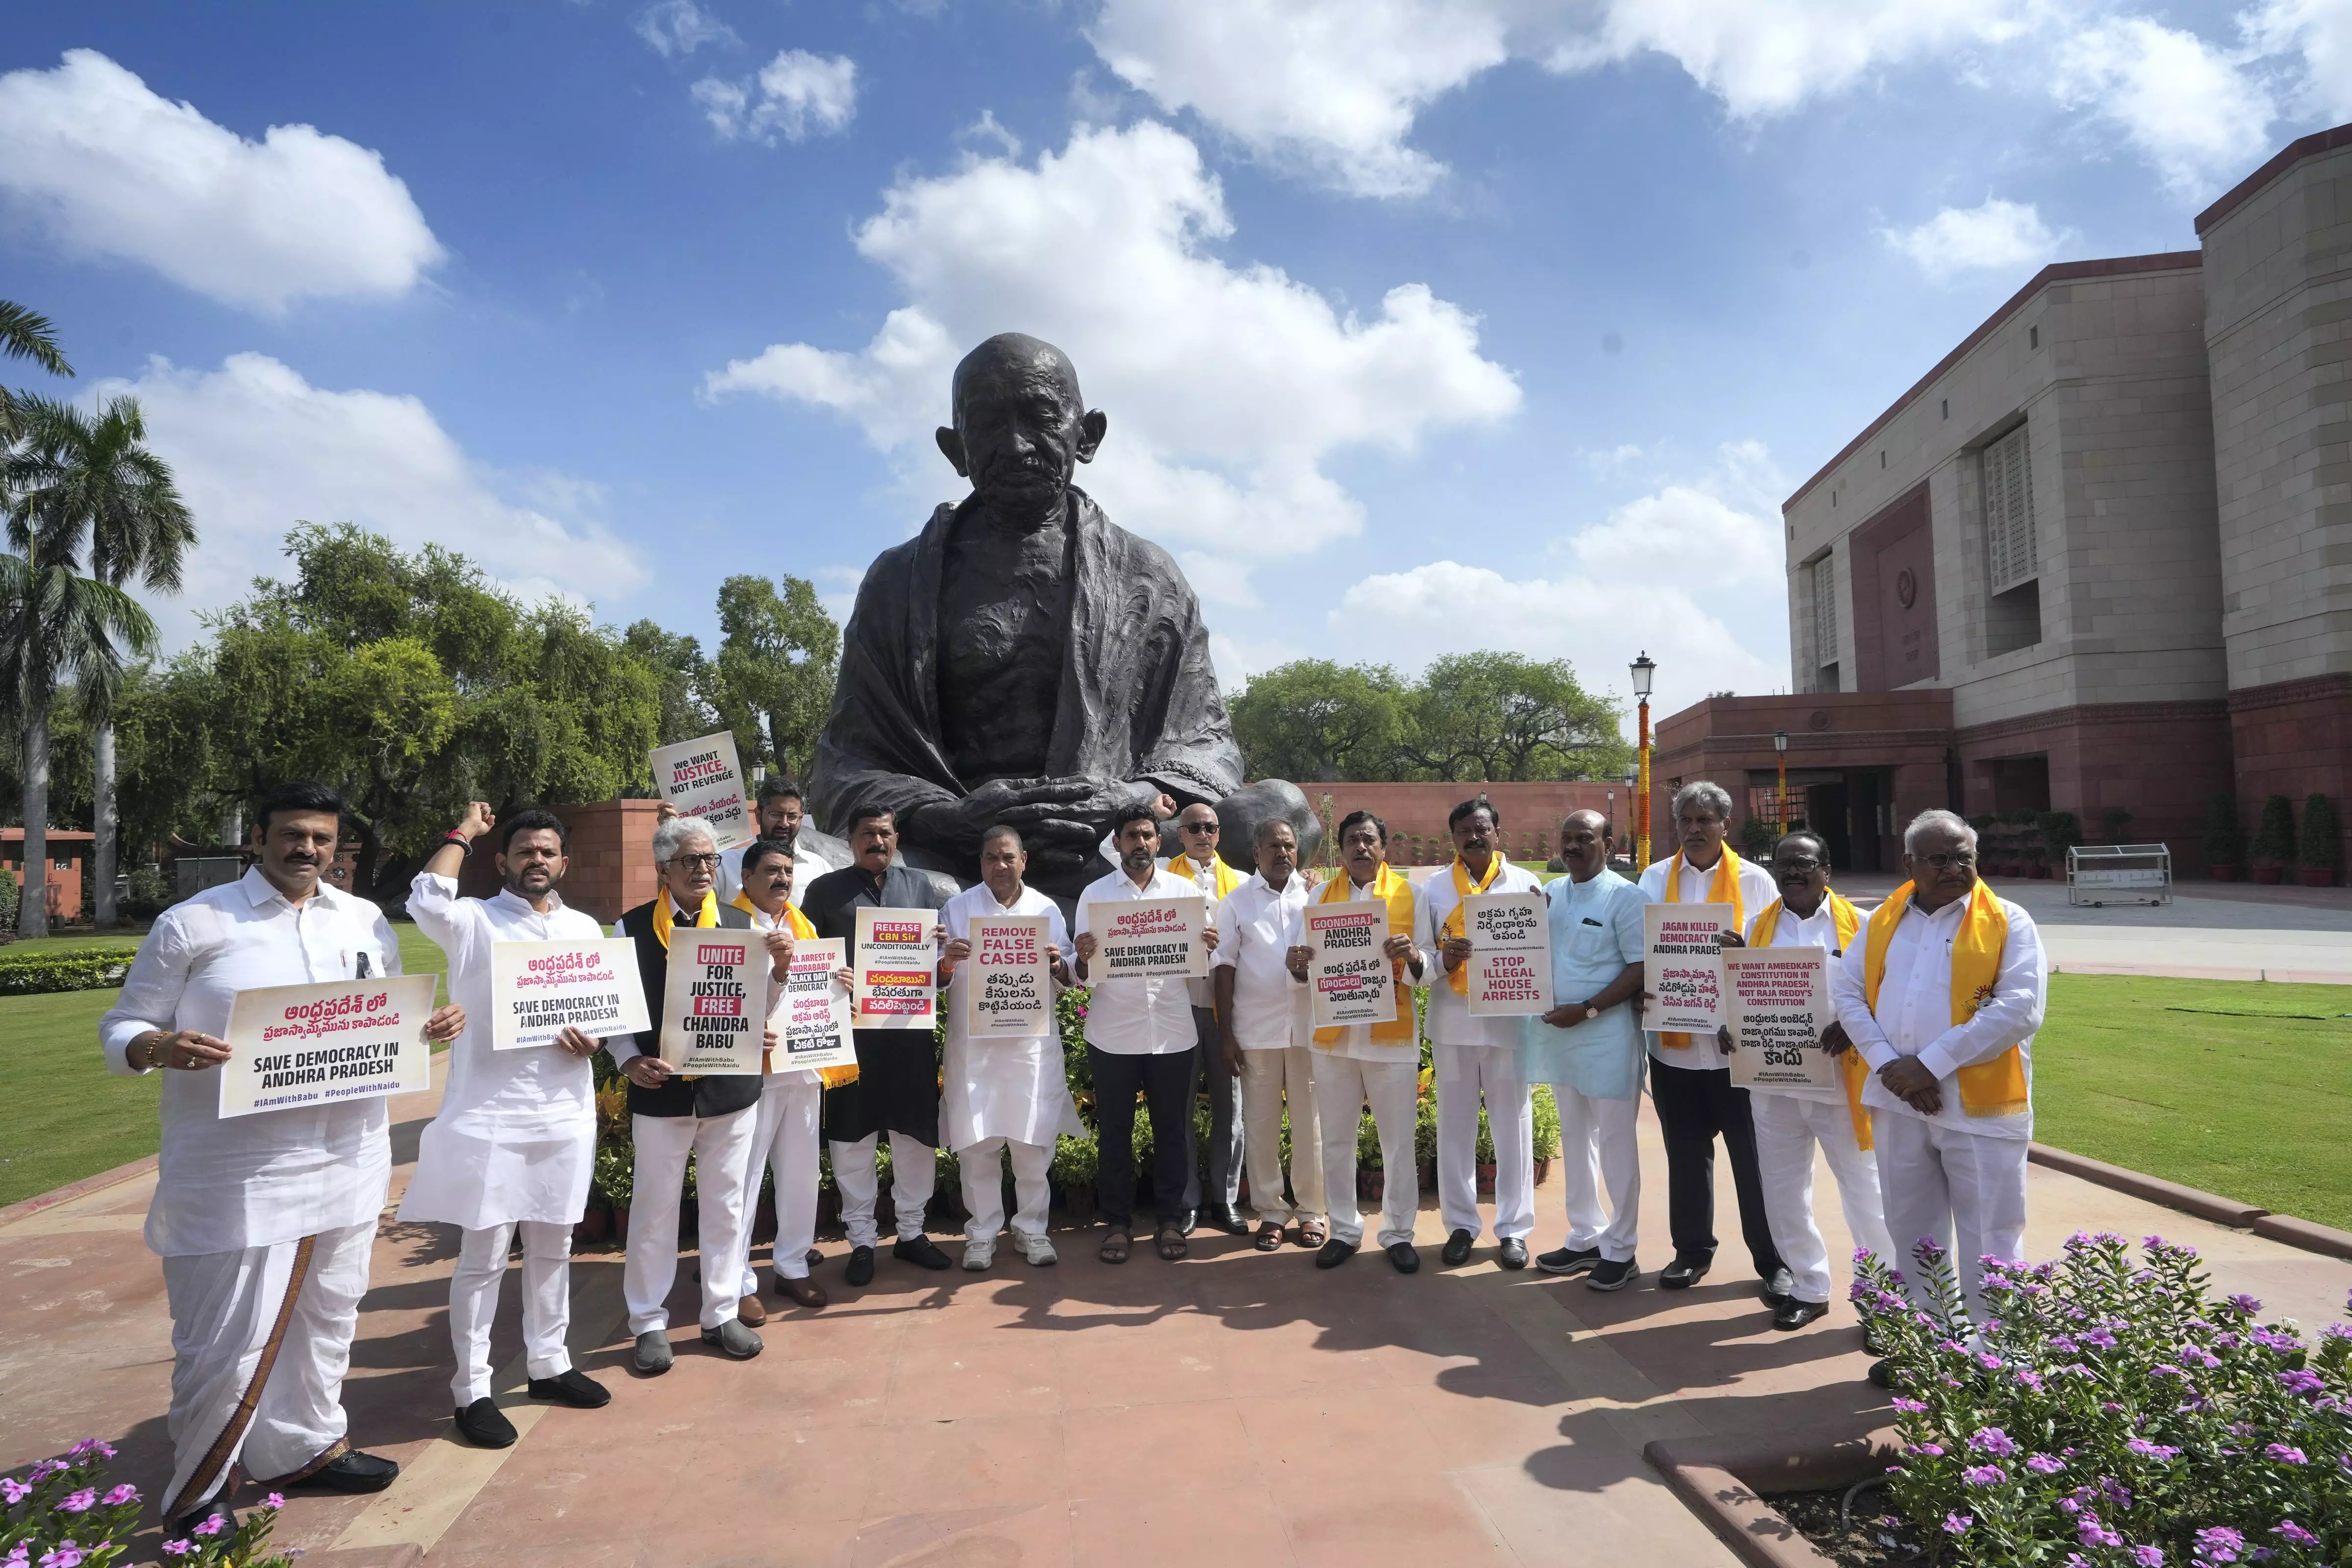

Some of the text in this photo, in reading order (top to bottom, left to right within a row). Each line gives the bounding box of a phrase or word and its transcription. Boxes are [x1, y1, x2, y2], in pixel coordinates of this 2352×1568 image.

[673, 750, 718, 770] we WANT
[673, 759, 727, 783] JUSTICE,
[670, 770, 734, 795] NOT REVENGE
[704, 806, 741, 826] క్షలు వద్దు
[1117, 909, 1176, 927] ఆంధ్రప్రదేశ్ లో
[1478, 907, 1532, 920] అక్రమ గృహ
[1314, 916, 1371, 929] GOONDARAJ
[1477, 918, 1537, 933] నిర్బంధాలను
[1662, 922, 1718, 932] JAGAN KILLED
[982, 928, 1036, 937] REMOVE
[1107, 923, 1187, 938] ప్రజాస్వామ్యమును కాపాడండి
[1325, 927, 1371, 940] ANDHRA
[1493, 929, 1525, 941] ఆపండి
[983, 939, 1034, 950] FALSE
[1324, 937, 1371, 949] PRADESH
[1660, 934, 1720, 943] DEMOCRACY IN
[701, 947, 742, 964] UNITE
[1104, 942, 1188, 957] SAVE DEMOCRACY IN
[1653, 944, 1721, 955] ANDHRA PRADES
[528, 952, 600, 975] ఆంధ్రప్రదేశ్ లో
[801, 954, 825, 963] ARREST
[980, 953, 1038, 965] CASES
[1110, 954, 1186, 967] ANDHRA PRADESH
[1493, 957, 1525, 967] STOP
[706, 965, 733, 980] FOR
[789, 963, 831, 972] ANDRABABU
[1323, 959, 1380, 976] ఆంధ్ర ప్రదేశ్ లో
[1484, 968, 1535, 978] ILLEGAL
[516, 970, 614, 989] ప్రజాస్వామ్యమును కాపాడండి
[791, 974, 812, 983] BLACK
[813, 972, 826, 982] DAY
[870, 973, 926, 986] చంద్రబాబుని
[987, 972, 1034, 988] తప్పుడు
[1320, 975, 1387, 989] గూండాలు రాజ్యం
[1663, 968, 1716, 983] ప్రజాస్వామ్యాన్ని
[690, 982, 746, 999] JUSTICE,
[788, 982, 828, 993] DEMOCRACY
[872, 985, 923, 998] భేషరతుగా
[1489, 979, 1532, 989] HOUSE
[1659, 983, 1719, 998] నడిరోడ్డుపై హత్య
[985, 986, 1035, 999] కేసులను
[1330, 988, 1380, 1003] ఏలుతున్నారు
[1482, 990, 1540, 1001] ARRESTS
[285, 993, 387, 1022] ఆంధ్రప్రదేశ్ లో
[513, 993, 620, 1014] SAVE DEMOCRACY IN
[701, 998, 735, 1014] FREE
[793, 998, 829, 1010] చంద్రబాబు
[869, 999, 925, 1014] వదిలిపెట్టండి
[979, 999, 1042, 1014] కొట్టివేయండి
[1662, 995, 1716, 1013] చేసిన జగన్ రెడ్డి
[520, 1007, 618, 1028] ANDHRA PRADESH
[792, 1008, 831, 1024] అక్రమ అరెస్ట్
[1743, 1014, 1779, 1026] ఆంధ్రులకు
[263, 1013, 400, 1041] ప్రజాస్వామ్యమును కాపాడండి
[683, 1016, 749, 1032] CHANDRA
[785, 1021, 839, 1038] ప్రజాస్వామ్యంలో
[516, 1024, 627, 1043] #IAmWithBab pleWithNaidu
[1741, 1028, 1817, 1040] రాజ్యాంగము కావాలి,
[696, 1034, 735, 1049] BABU
[793, 1037, 836, 1050] చీకటి రోజు
[1741, 1039, 1821, 1052] రాజా రెడ్డి రాజ్యాంగము
[253, 1042, 399, 1073] SAVE DEMOCRACY IN
[791, 1056, 838, 1065] #PeopleWithNaidu
[1764, 1047, 1803, 1066] కాదు
[262, 1059, 393, 1089] ANDHRA PRADESH
[253, 1081, 400, 1108] #IAmWithBabu #PeopleWithNaidu
